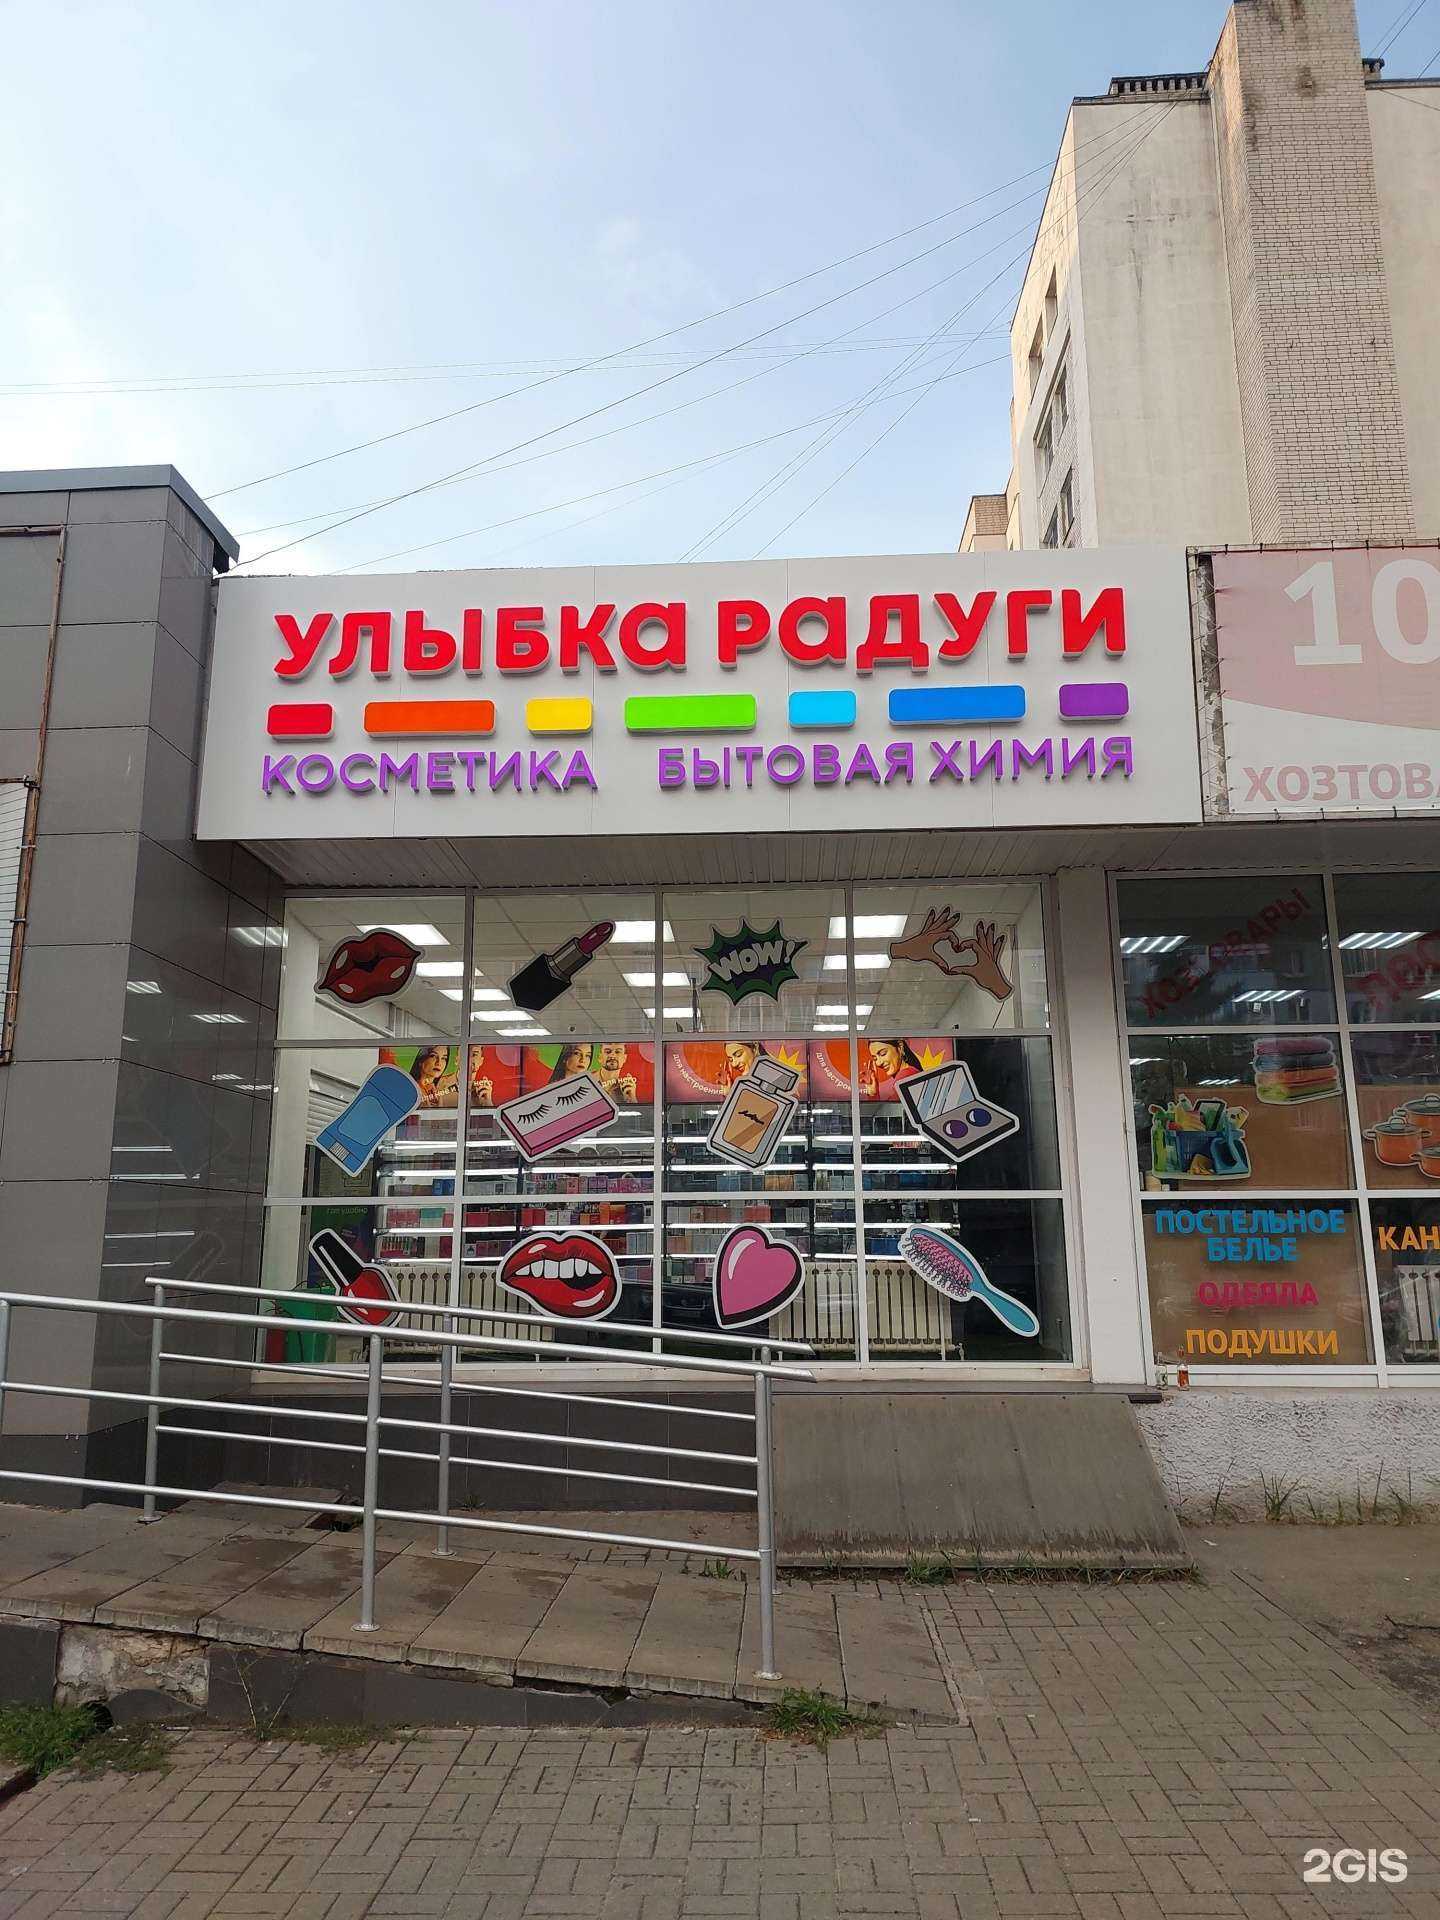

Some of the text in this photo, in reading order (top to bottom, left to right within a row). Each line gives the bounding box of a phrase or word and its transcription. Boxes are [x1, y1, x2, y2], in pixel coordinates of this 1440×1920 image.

[262, 736, 1135, 795] КОСМЕТИКА БЫТОВАЯ ХИМИЯ
[1242, 762, 1440, 801] ХОЗТОВ
[708, 940, 796, 982] WOW!
[679, 1067, 726, 1096] настроения
[823, 1066, 868, 1095] настроя
[1155, 1209, 1346, 1234] ПОСТЕЛЬНОЕ
[1207, 1237, 1297, 1262] БЕЛЬЕ
[1378, 1225, 1440, 1251] КАН
[1198, 1281, 1319, 1309] ОДЕЯЛА
[1186, 1329, 1339, 1358] ПОДУШКИ
